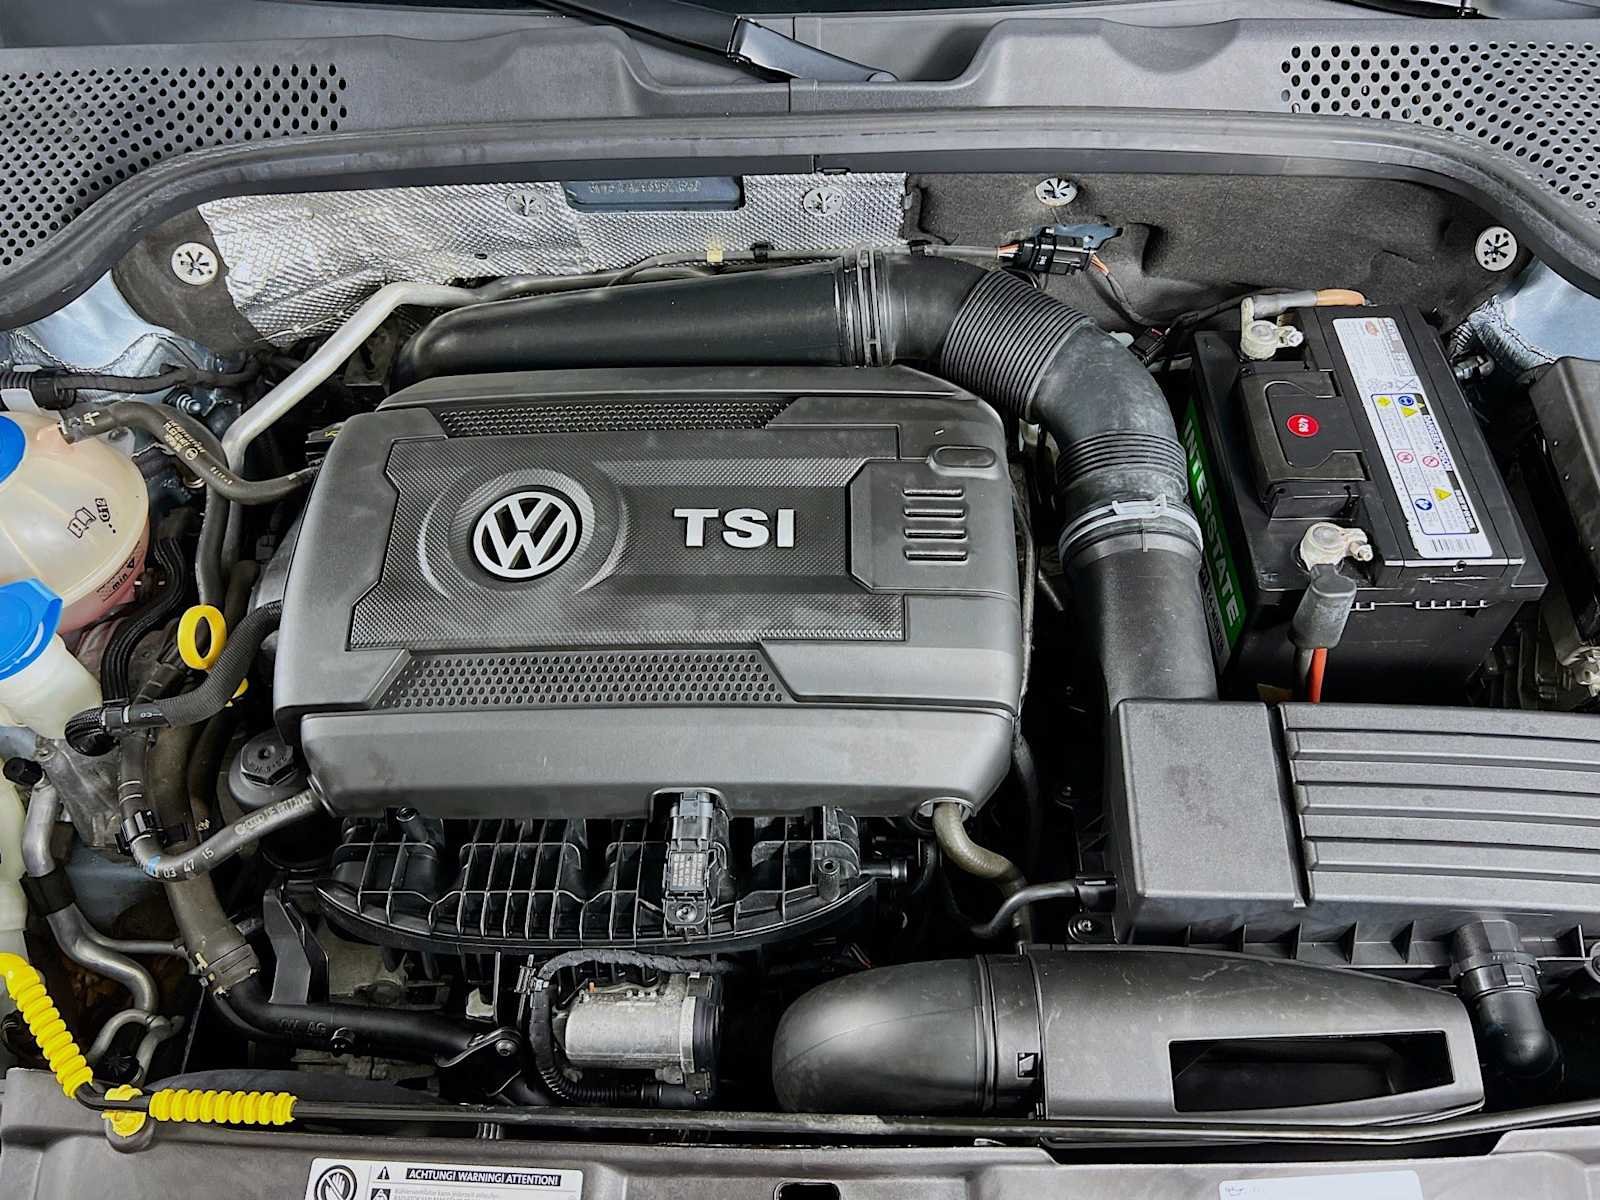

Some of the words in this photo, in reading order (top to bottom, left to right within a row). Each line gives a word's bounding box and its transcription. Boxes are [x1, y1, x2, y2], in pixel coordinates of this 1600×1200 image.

[473, 491, 577, 579] VW
[673, 507, 797, 549] TSI
[1185, 418, 1240, 627] INTERSTATE
[163, 866, 177, 879] 03
[202, 847, 215, 860] 15
[409, 1168, 456, 1181] ACHTUNG!
[457, 1171, 505, 1183] WARNING!
[505, 1173, 559, 1186] ATTENTION!
